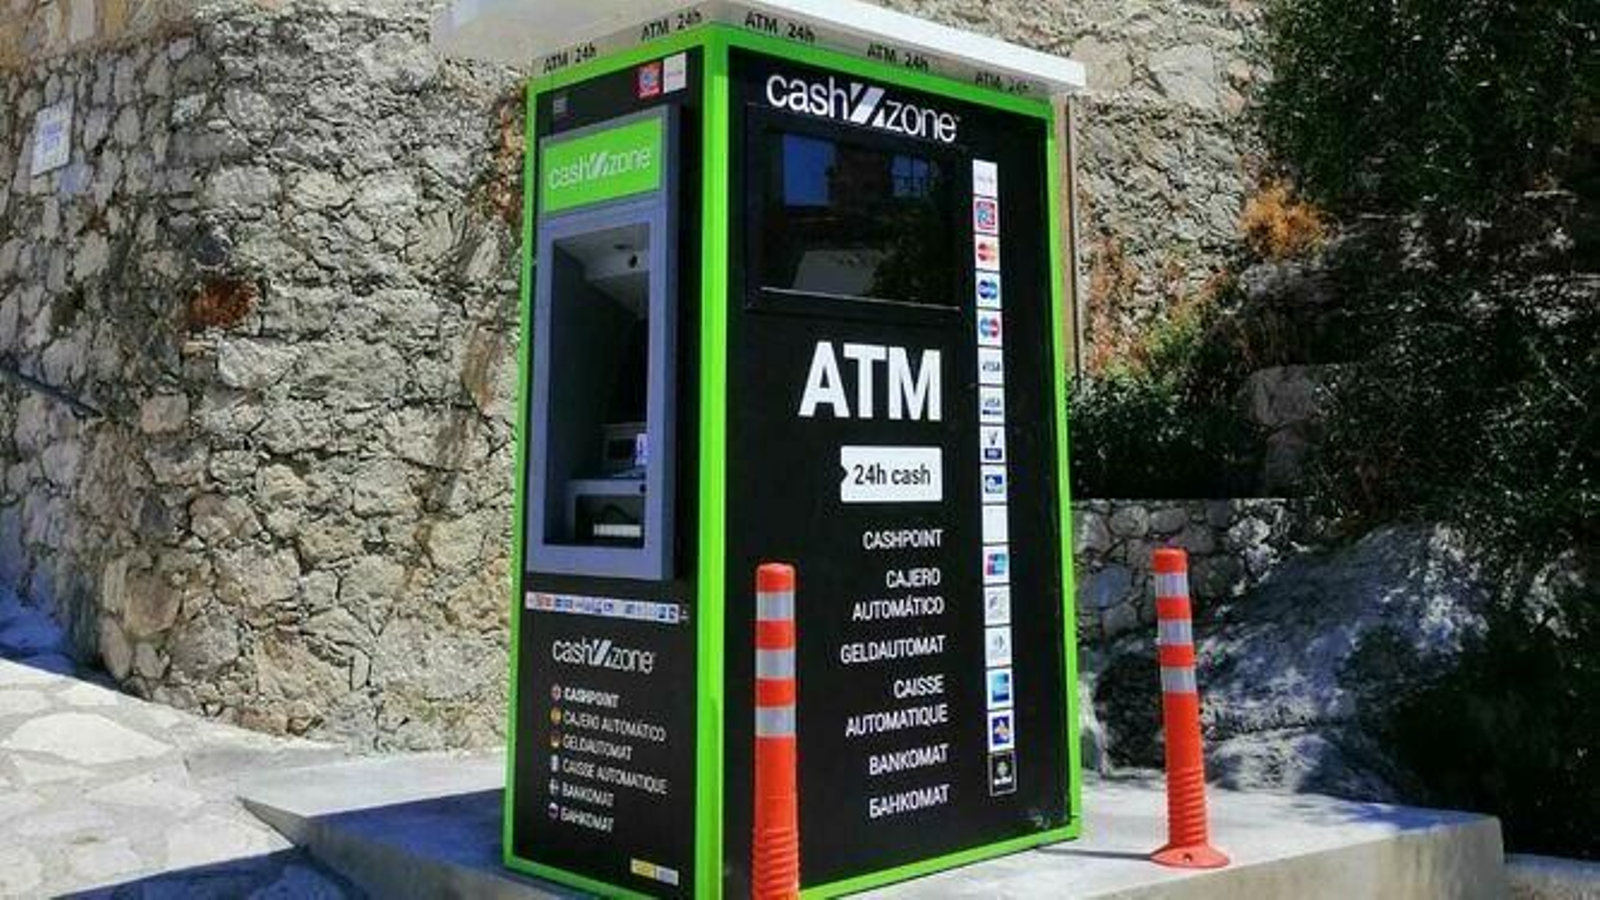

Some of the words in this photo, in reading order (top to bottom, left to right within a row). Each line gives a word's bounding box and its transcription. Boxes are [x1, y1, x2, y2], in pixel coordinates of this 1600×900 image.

[642, 19, 669, 40] ATM
[677, 10, 701, 30] 24h
[745, 12, 777, 34] ATM
[788, 18, 815, 43] 24h
[543, 53, 568, 74] ATM
[575, 43, 597, 63] 24h
[867, 43, 897, 66] ATM
[905, 48, 929, 71] 24h
[975, 71, 1001, 92] ATM
[798, 340, 942, 421] ATM
[854, 463, 887, 485] 24h
[891, 463, 931, 485] cash
[862, 528, 943, 550] CASHPOINT
[886, 567, 941, 588] CAJERO
[852, 594, 945, 622] AUTOMÁTICO
[840, 634, 946, 664] GELDAUTOMAT
[564, 687, 619, 708] CASHPOINT
[893, 674, 944, 699] CAISSE
[563, 711, 600, 730] CAJERO
[845, 703, 949, 738] AUTOMATIQUE
[562, 733, 633, 761] GELDAUTOMAT
[869, 743, 949, 775] BANKOMAT
[562, 757, 596, 779] CAISSE
[597, 766, 668, 795] AUTOMATIQUE
[562, 781, 615, 807] BANKOMAT
[869, 784, 950, 819] БАНКОМАТ
